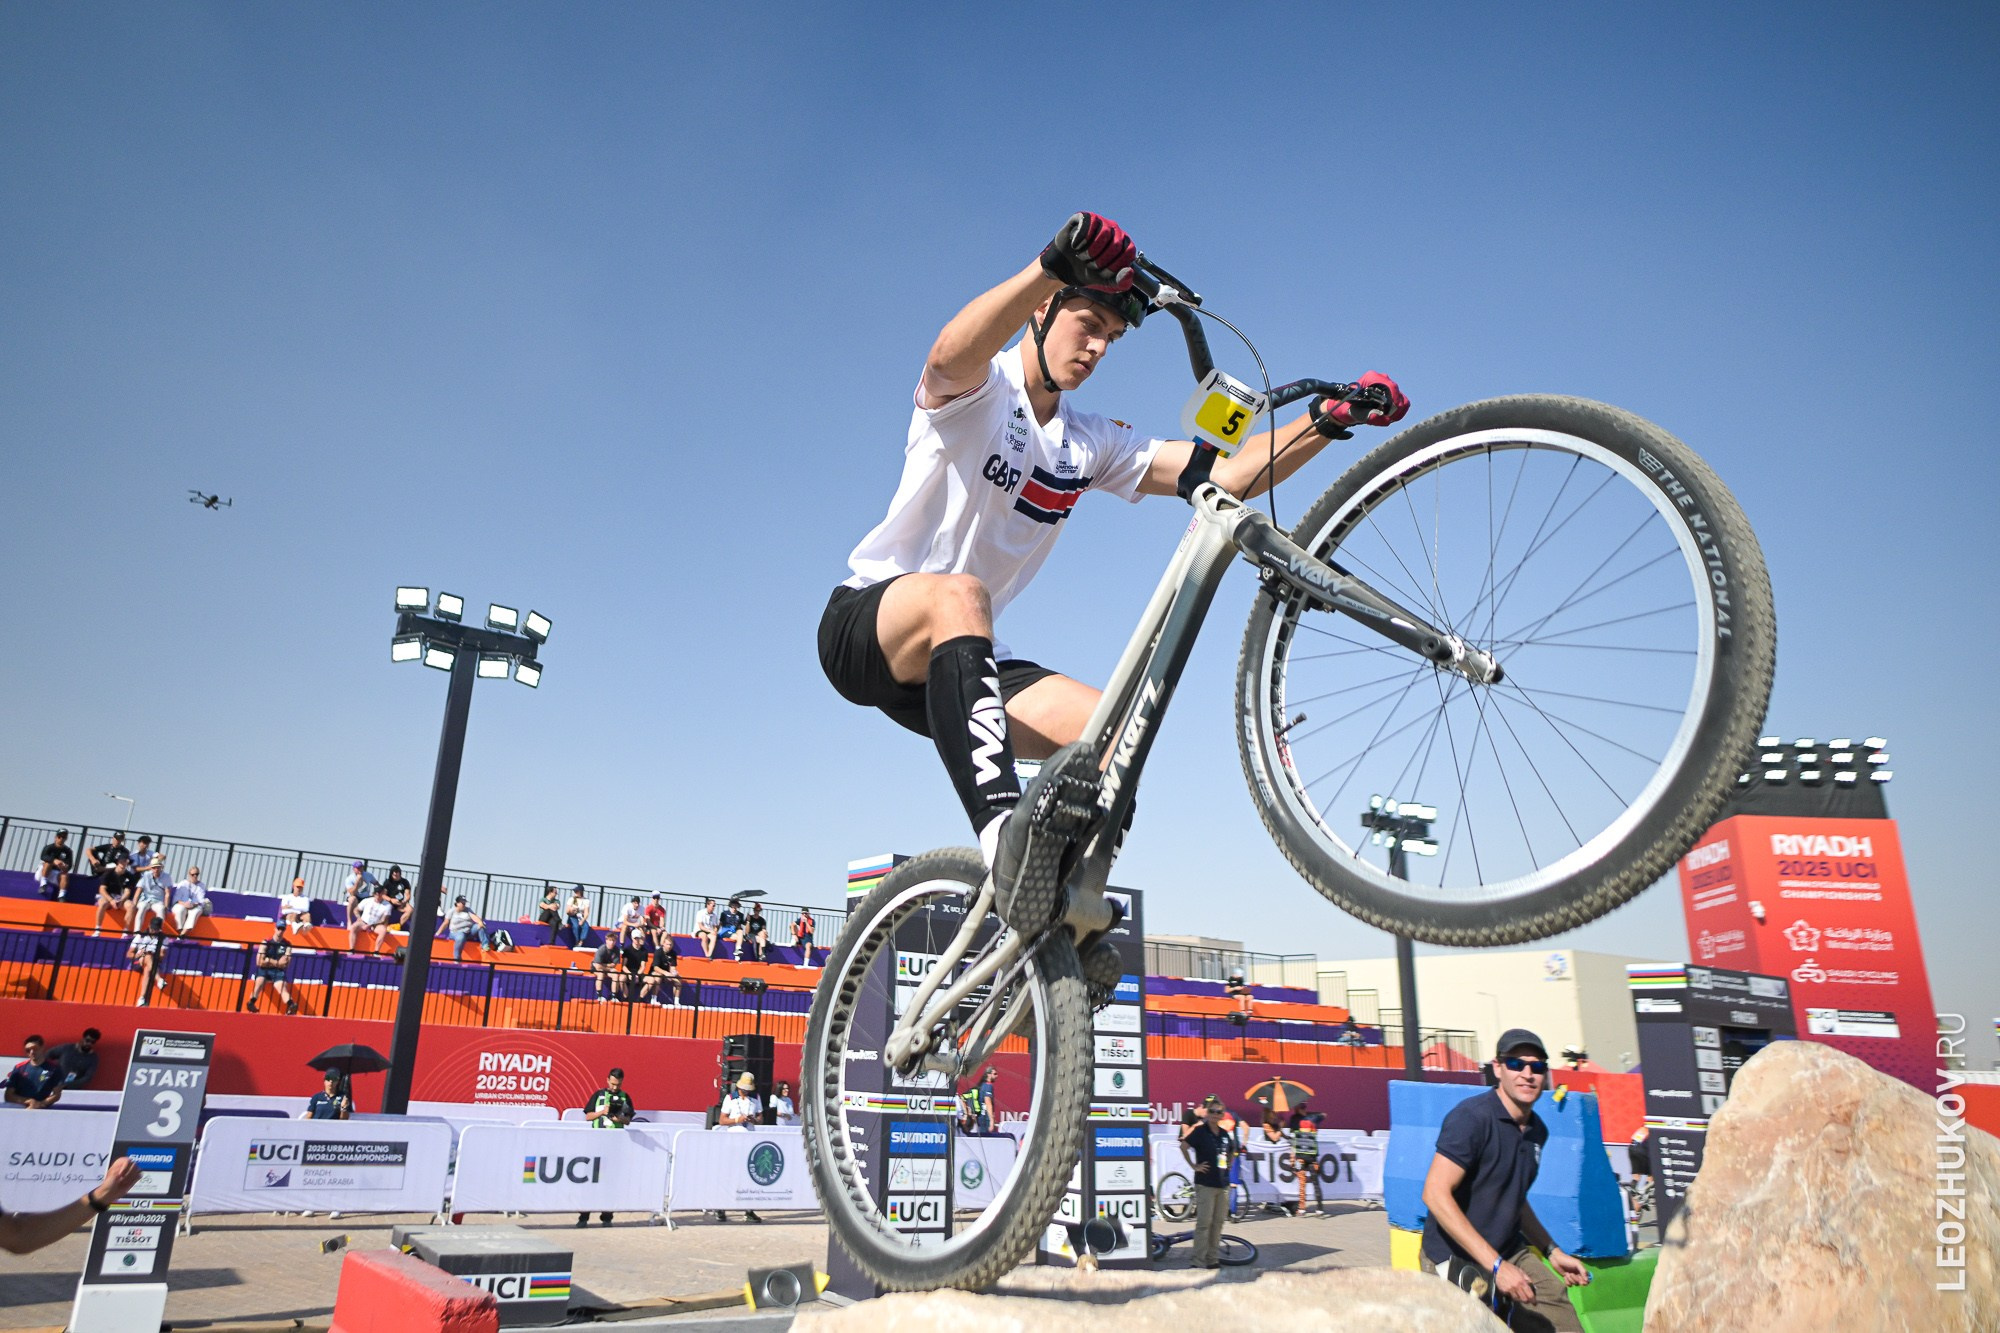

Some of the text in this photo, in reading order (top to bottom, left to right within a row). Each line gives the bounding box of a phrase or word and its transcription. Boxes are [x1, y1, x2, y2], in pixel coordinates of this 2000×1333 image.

[1216, 379, 1229, 390] UCI
[1221, 410, 1246, 436] 5
[982, 453, 1022, 495] GBR
[1657, 468, 1695, 508] THE
[1688, 513, 1732, 639] NATIONAL
[1770, 833, 1874, 858] RIYADH
[1778, 860, 1878, 879] 2025 UCI
[1100, 1048, 1135, 1058] TISSOT
[478, 1051, 553, 1074] RIYADH
[132, 1067, 203, 1088] START
[475, 1074, 551, 1092] 2025 UCI
[849, 1095, 866, 1107] UCI
[908, 1099, 932, 1111] UCI
[146, 1090, 184, 1137] 3
[1109, 1107, 1129, 1118] UCI
[891, 1131, 947, 1144] SHIMANO
[1095, 1137, 1144, 1148] SHIMANO
[259, 1144, 300, 1161] UCI
[307, 1144, 390, 1153] 2025 URBAN CYCLING
[9, 1151, 76, 1167] SAUDI
[129, 1153, 174, 1164] SHIMANO
[306, 1154, 403, 1162] WORLD CHAMPIONSHIPS
[303, 1169, 332, 1177] RIYADH
[538, 1156, 601, 1184] UCI
[1245, 1152, 1357, 1184] TISOT
[302, 1178, 355, 1186] SAUDI ARABIA
[131, 1200, 150, 1209] UCI
[899, 1201, 939, 1222] UCI
[1107, 1200, 1139, 1219] UCI
[108, 1214, 167, 1225] #Riyadh2025
